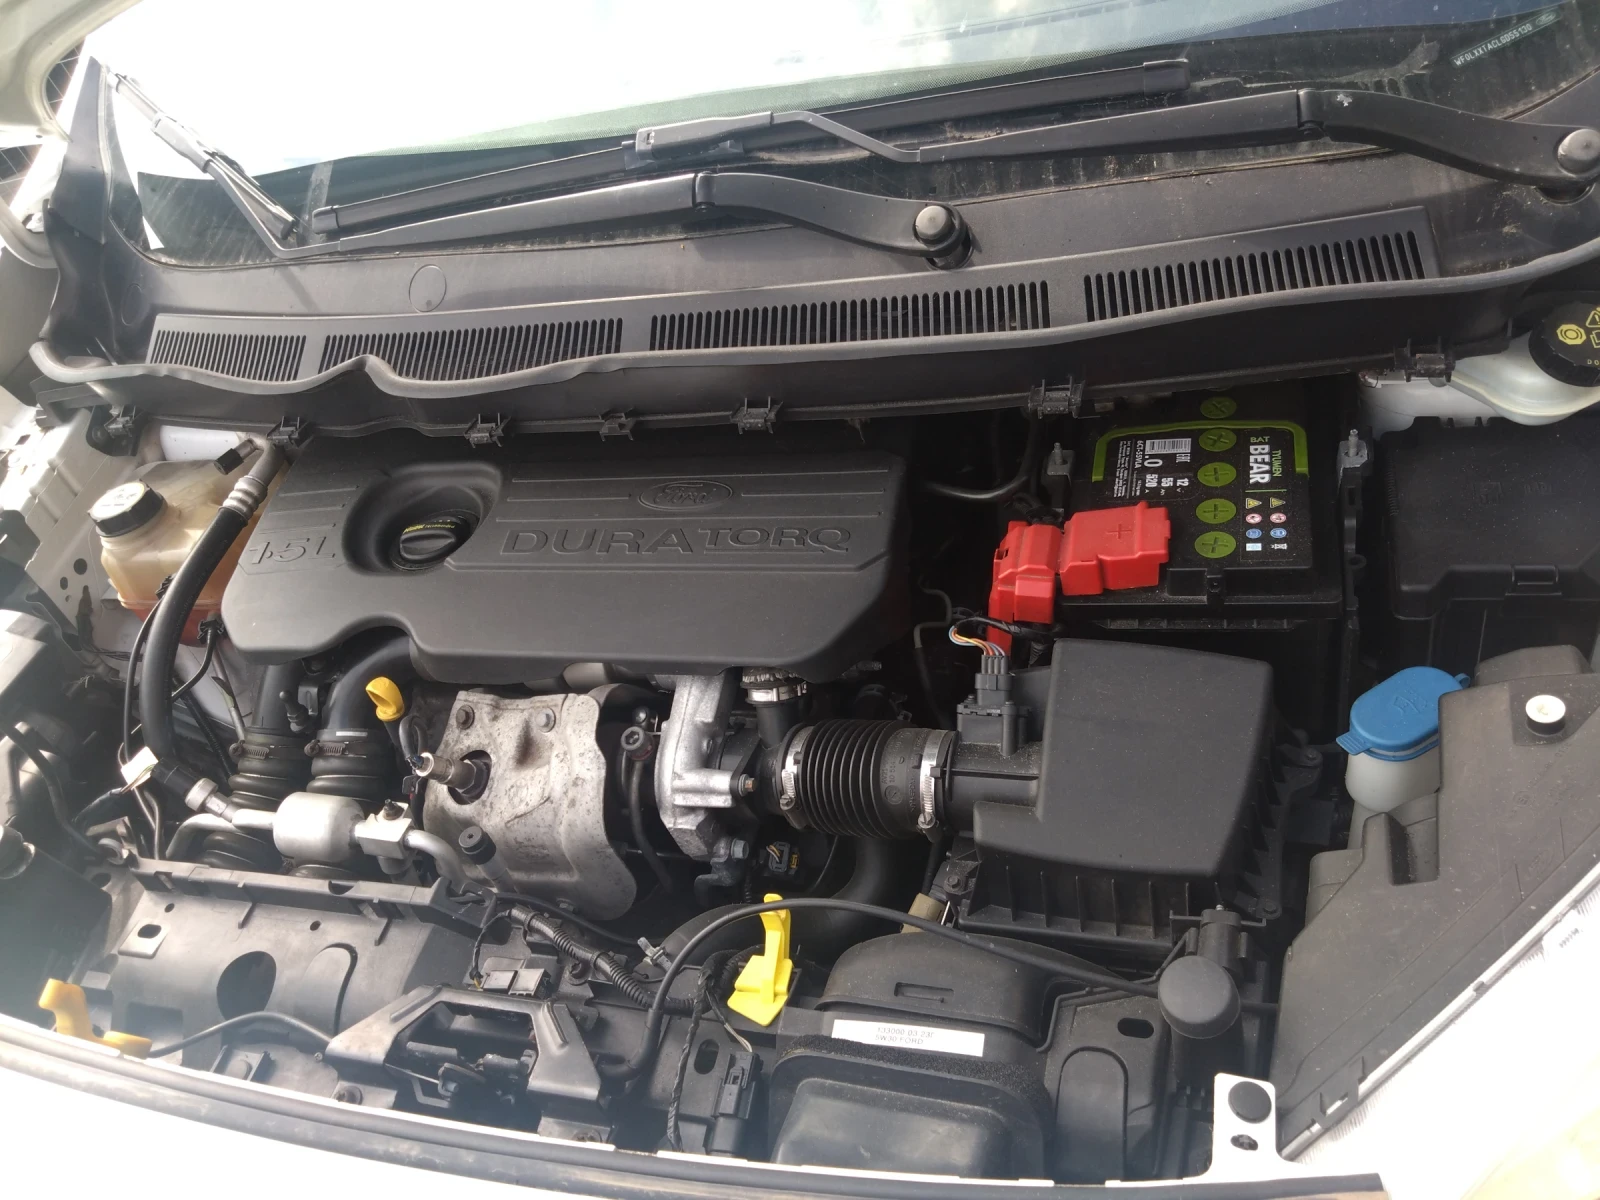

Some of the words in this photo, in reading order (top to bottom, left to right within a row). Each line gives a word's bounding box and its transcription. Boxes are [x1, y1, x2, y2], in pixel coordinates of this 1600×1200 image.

[1250, 435, 1270, 443] BAT
[1249, 444, 1270, 484] BEAR
[1271, 449, 1282, 478] TYUMEN
[1145, 473, 1159, 488] 520
[1161, 477, 1174, 487] 55
[1176, 477, 1189, 487] 12
[499, 527, 852, 555] DURATORQ
[875, 1034, 897, 1042] 5W30
